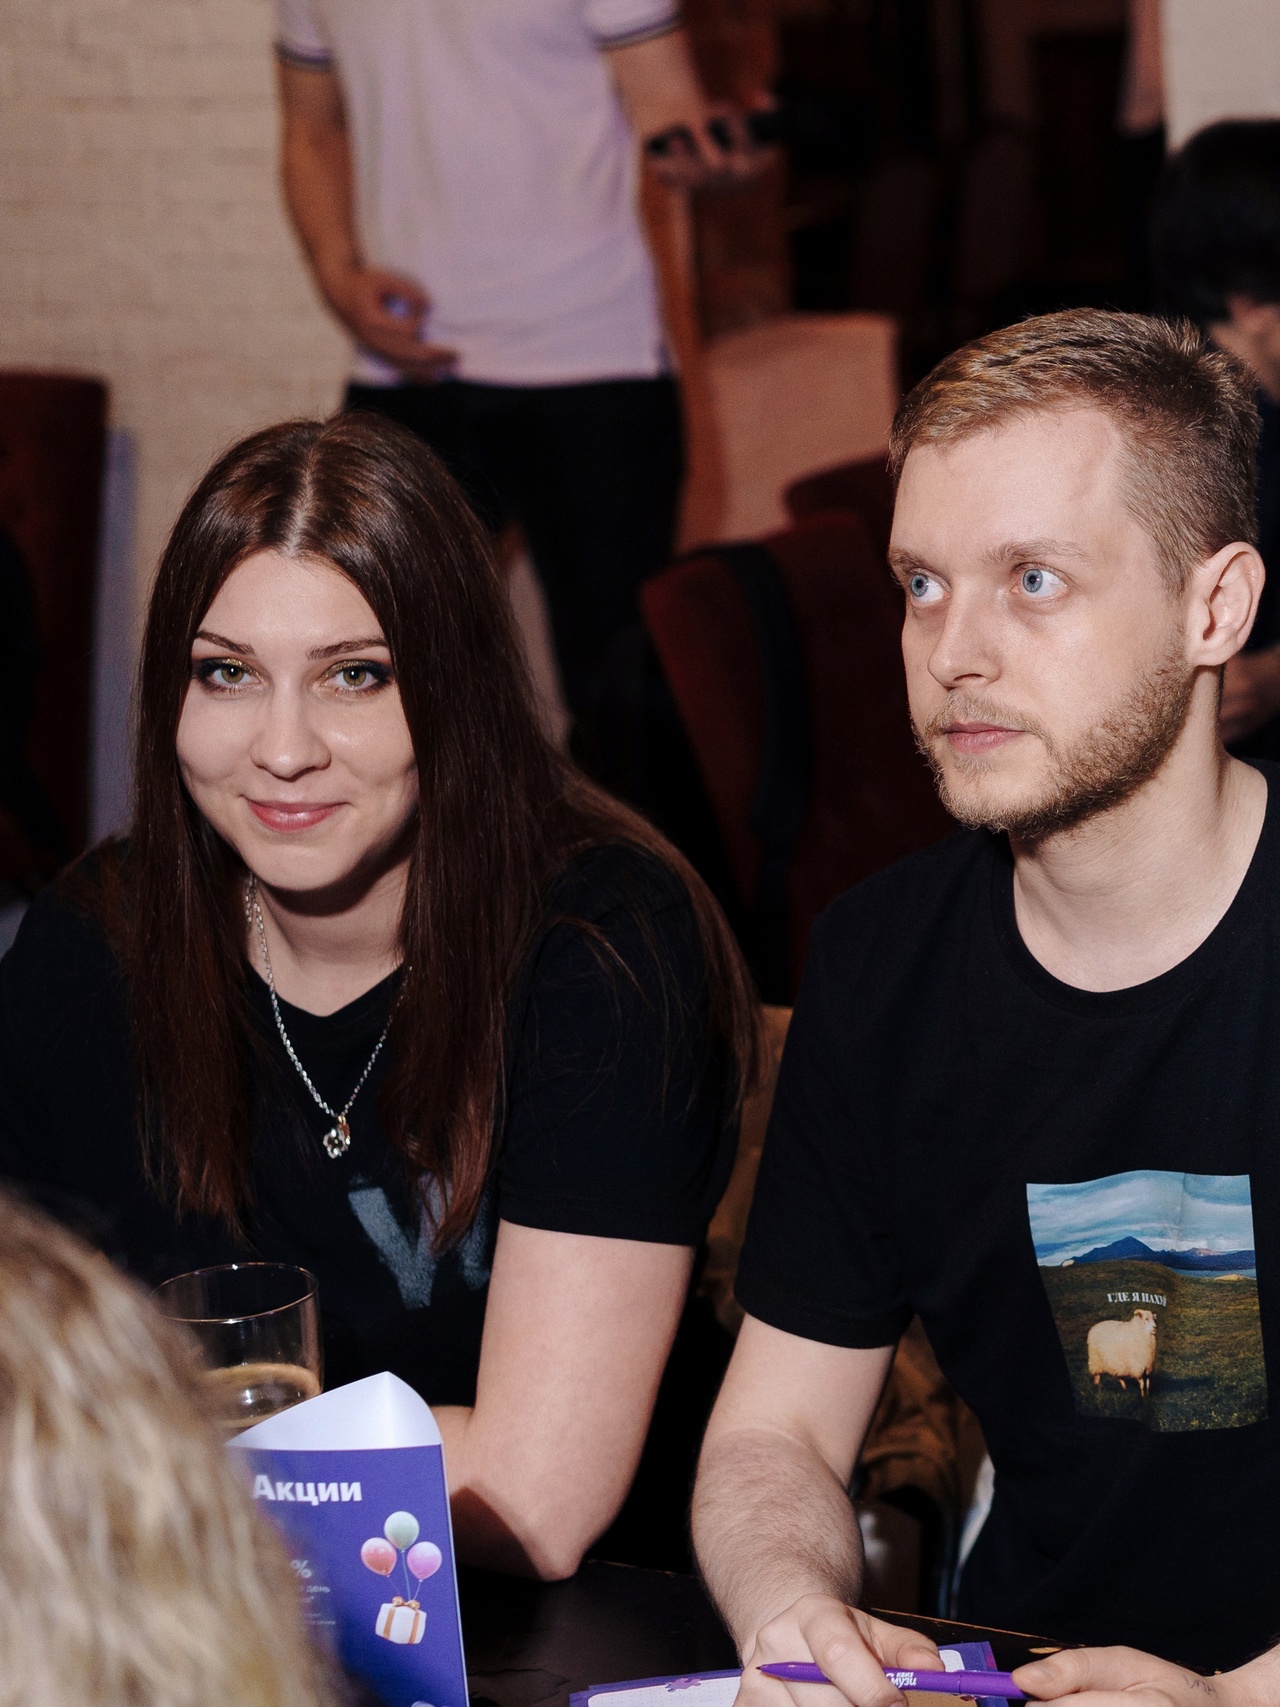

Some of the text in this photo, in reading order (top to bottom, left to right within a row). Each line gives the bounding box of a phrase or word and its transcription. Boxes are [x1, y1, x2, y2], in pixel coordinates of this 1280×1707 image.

[1107, 1291, 1130, 1303] ГДЕ
[1131, 1291, 1140, 1302] Я
[252, 1474, 363, 1506] Акции
